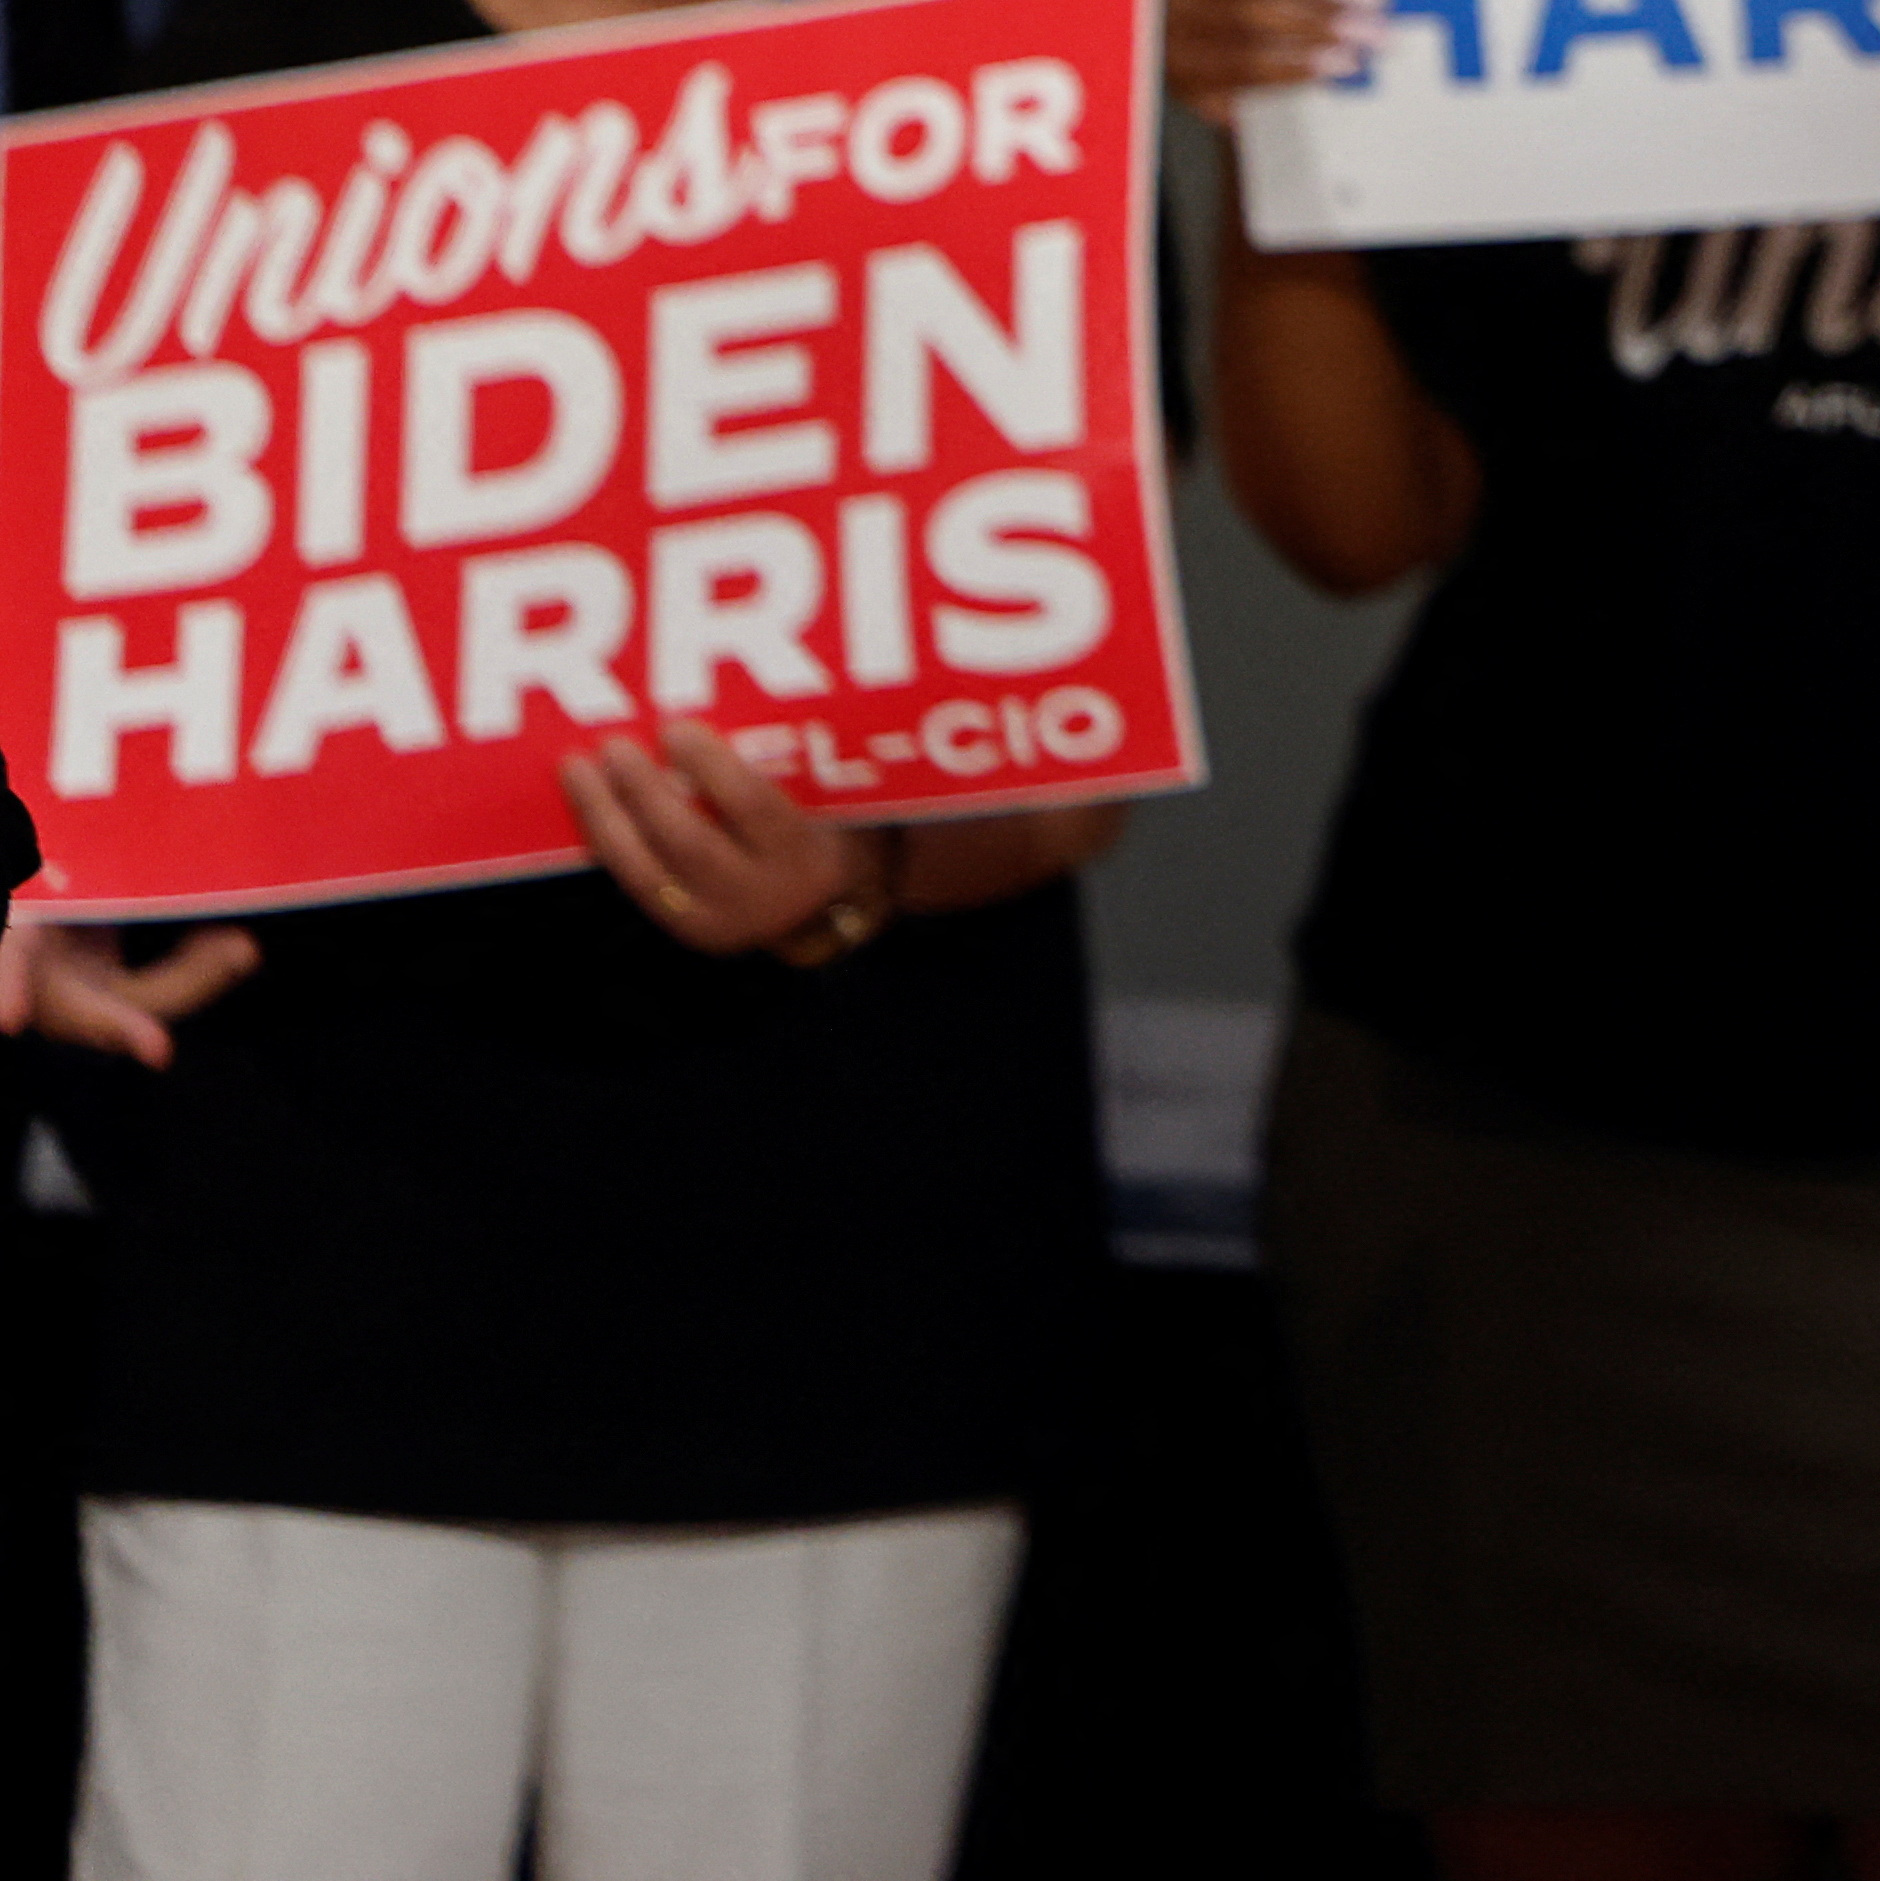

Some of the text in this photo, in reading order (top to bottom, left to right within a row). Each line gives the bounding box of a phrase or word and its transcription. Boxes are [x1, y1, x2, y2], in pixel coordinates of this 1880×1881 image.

[40, 55, 1087, 390] Unions FOR
[62, 216, 1088, 602] BIDEN
[47, 466, 1116, 802] HARRIS
[730, 684, 1125, 793] FL-CIO
